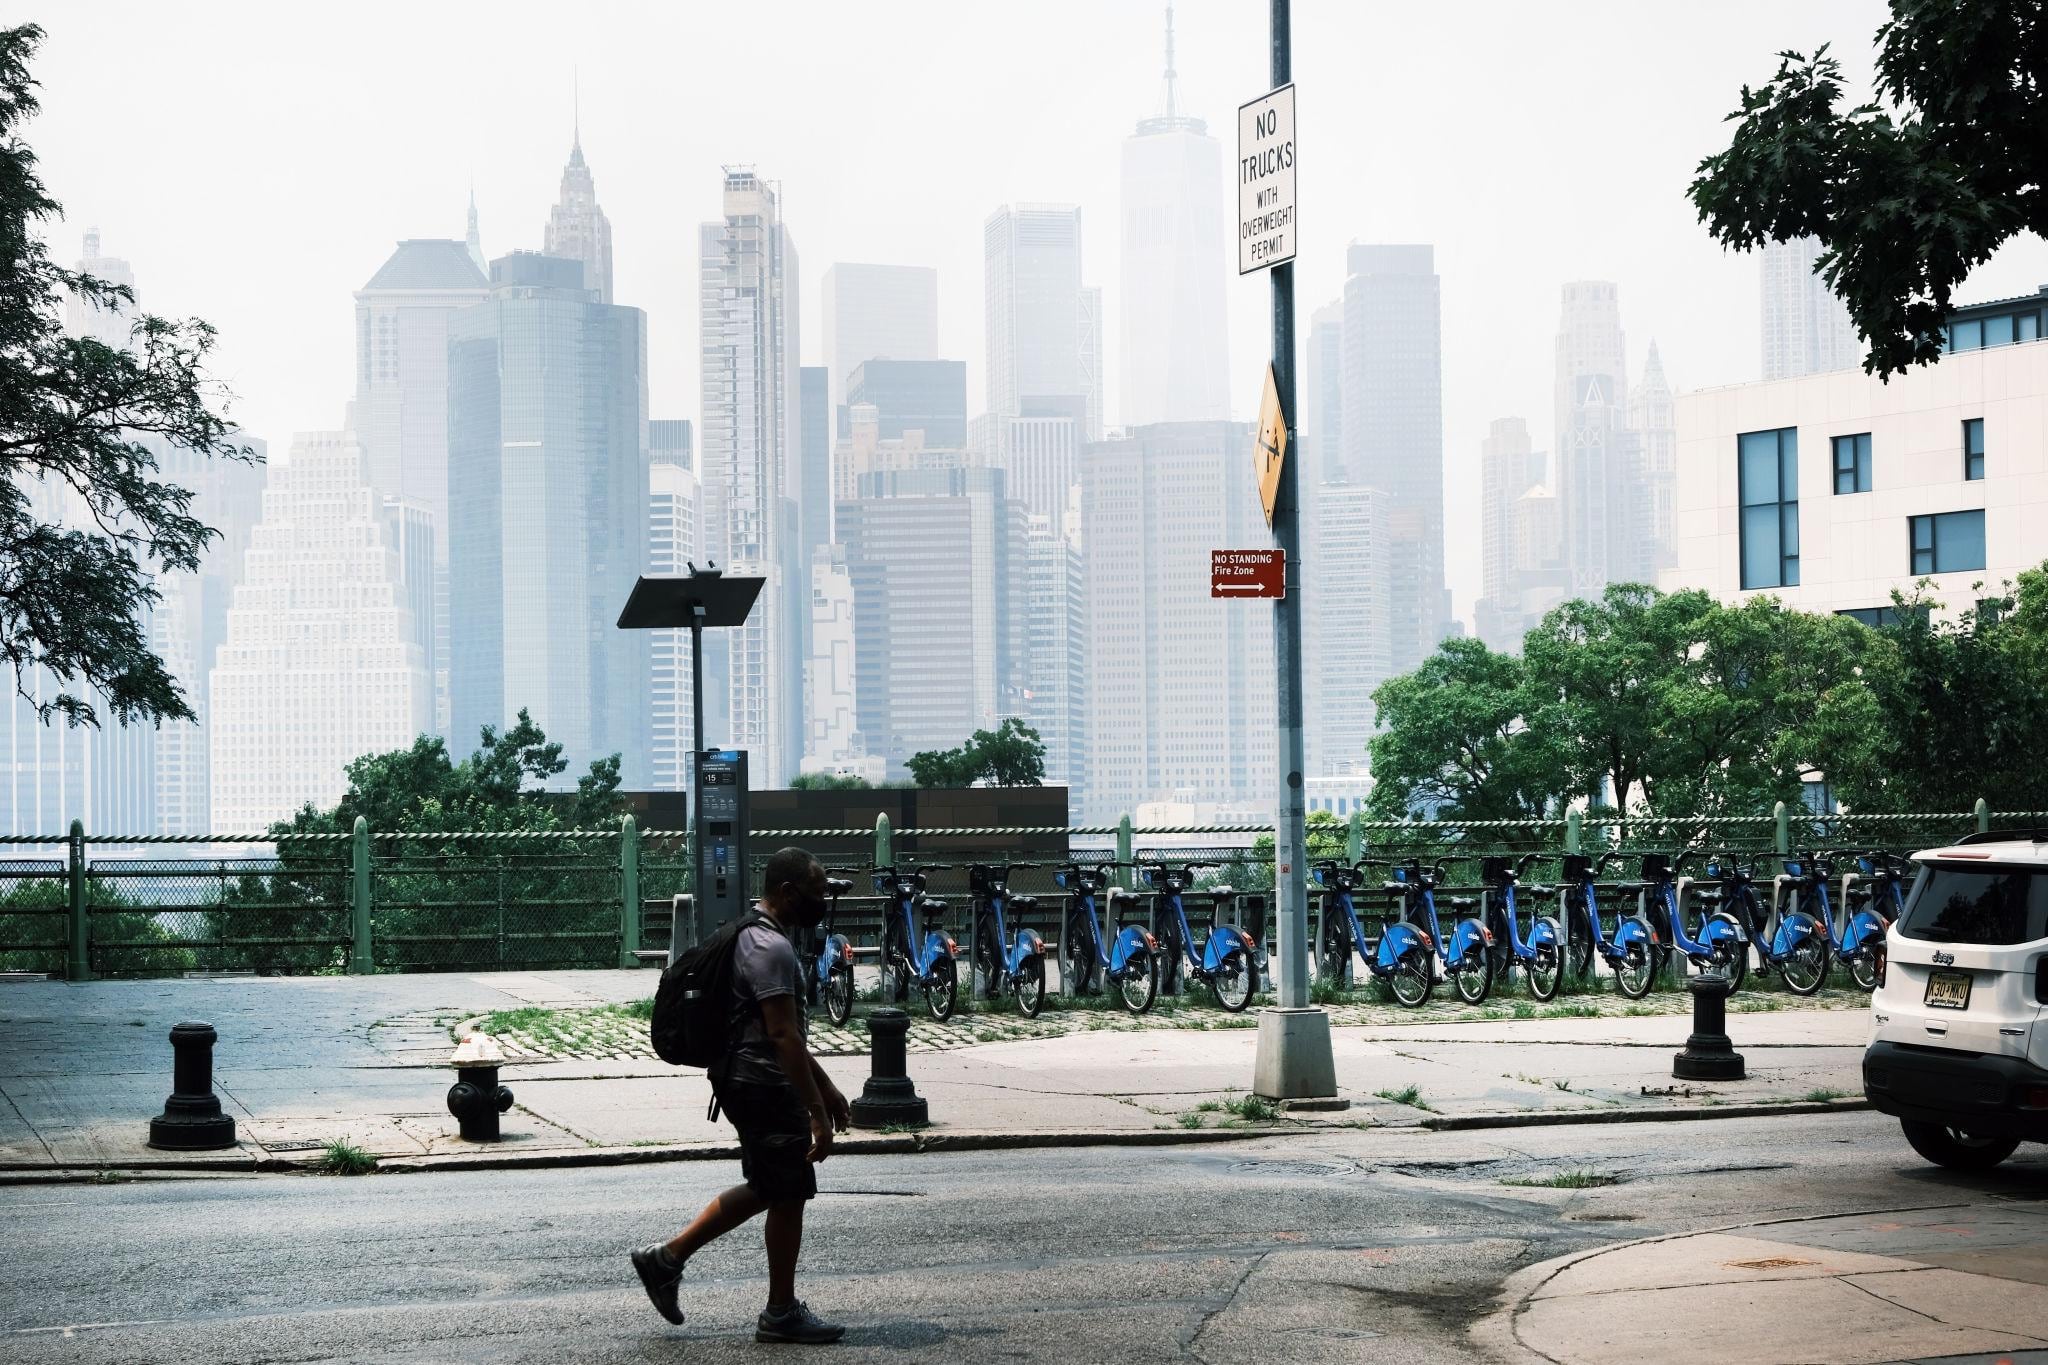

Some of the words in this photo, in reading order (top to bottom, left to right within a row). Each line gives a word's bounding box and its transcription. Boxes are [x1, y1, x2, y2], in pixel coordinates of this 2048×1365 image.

[1256, 108, 1276, 141] NO
[1241, 141, 1293, 184] TRUCKS
[1257, 185, 1278, 210] WITH
[1242, 205, 1293, 240] OVERWEIGHT
[1251, 234, 1284, 262] PERMIT
[1214, 554, 1227, 564] NO
[1229, 554, 1273, 564] STANDING
[1214, 566, 1232, 576] Fire
[1233, 566, 1255, 576] Zone
[1932, 949, 1955, 966] Jeep
